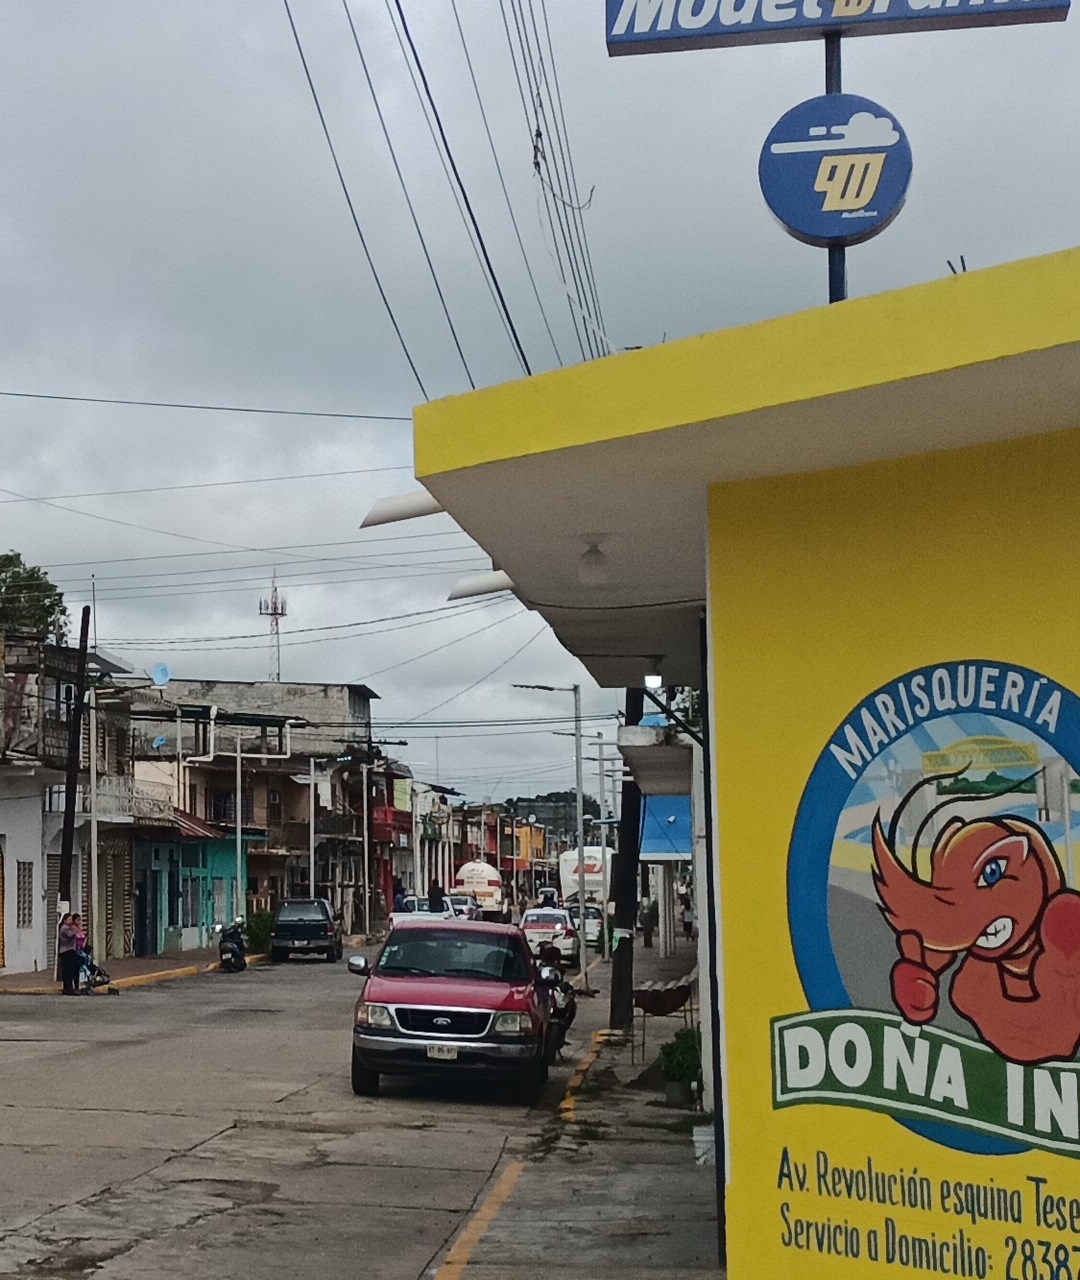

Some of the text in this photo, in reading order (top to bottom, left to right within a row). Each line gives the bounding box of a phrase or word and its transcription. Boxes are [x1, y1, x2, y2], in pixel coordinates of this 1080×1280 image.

[829, 665, 1063, 780] MARISQUERÍA
[783, 1020, 969, 1110] DOÑA
[777, 1146, 810, 1193] Av.
[816, 1150, 932, 1211] Revolución
[940, 1177, 1022, 1225] esquina
[780, 1202, 860, 1259] Servicio
[867, 1227, 879, 1262] a
[884, 1217, 994, 1280] Domicilio:
